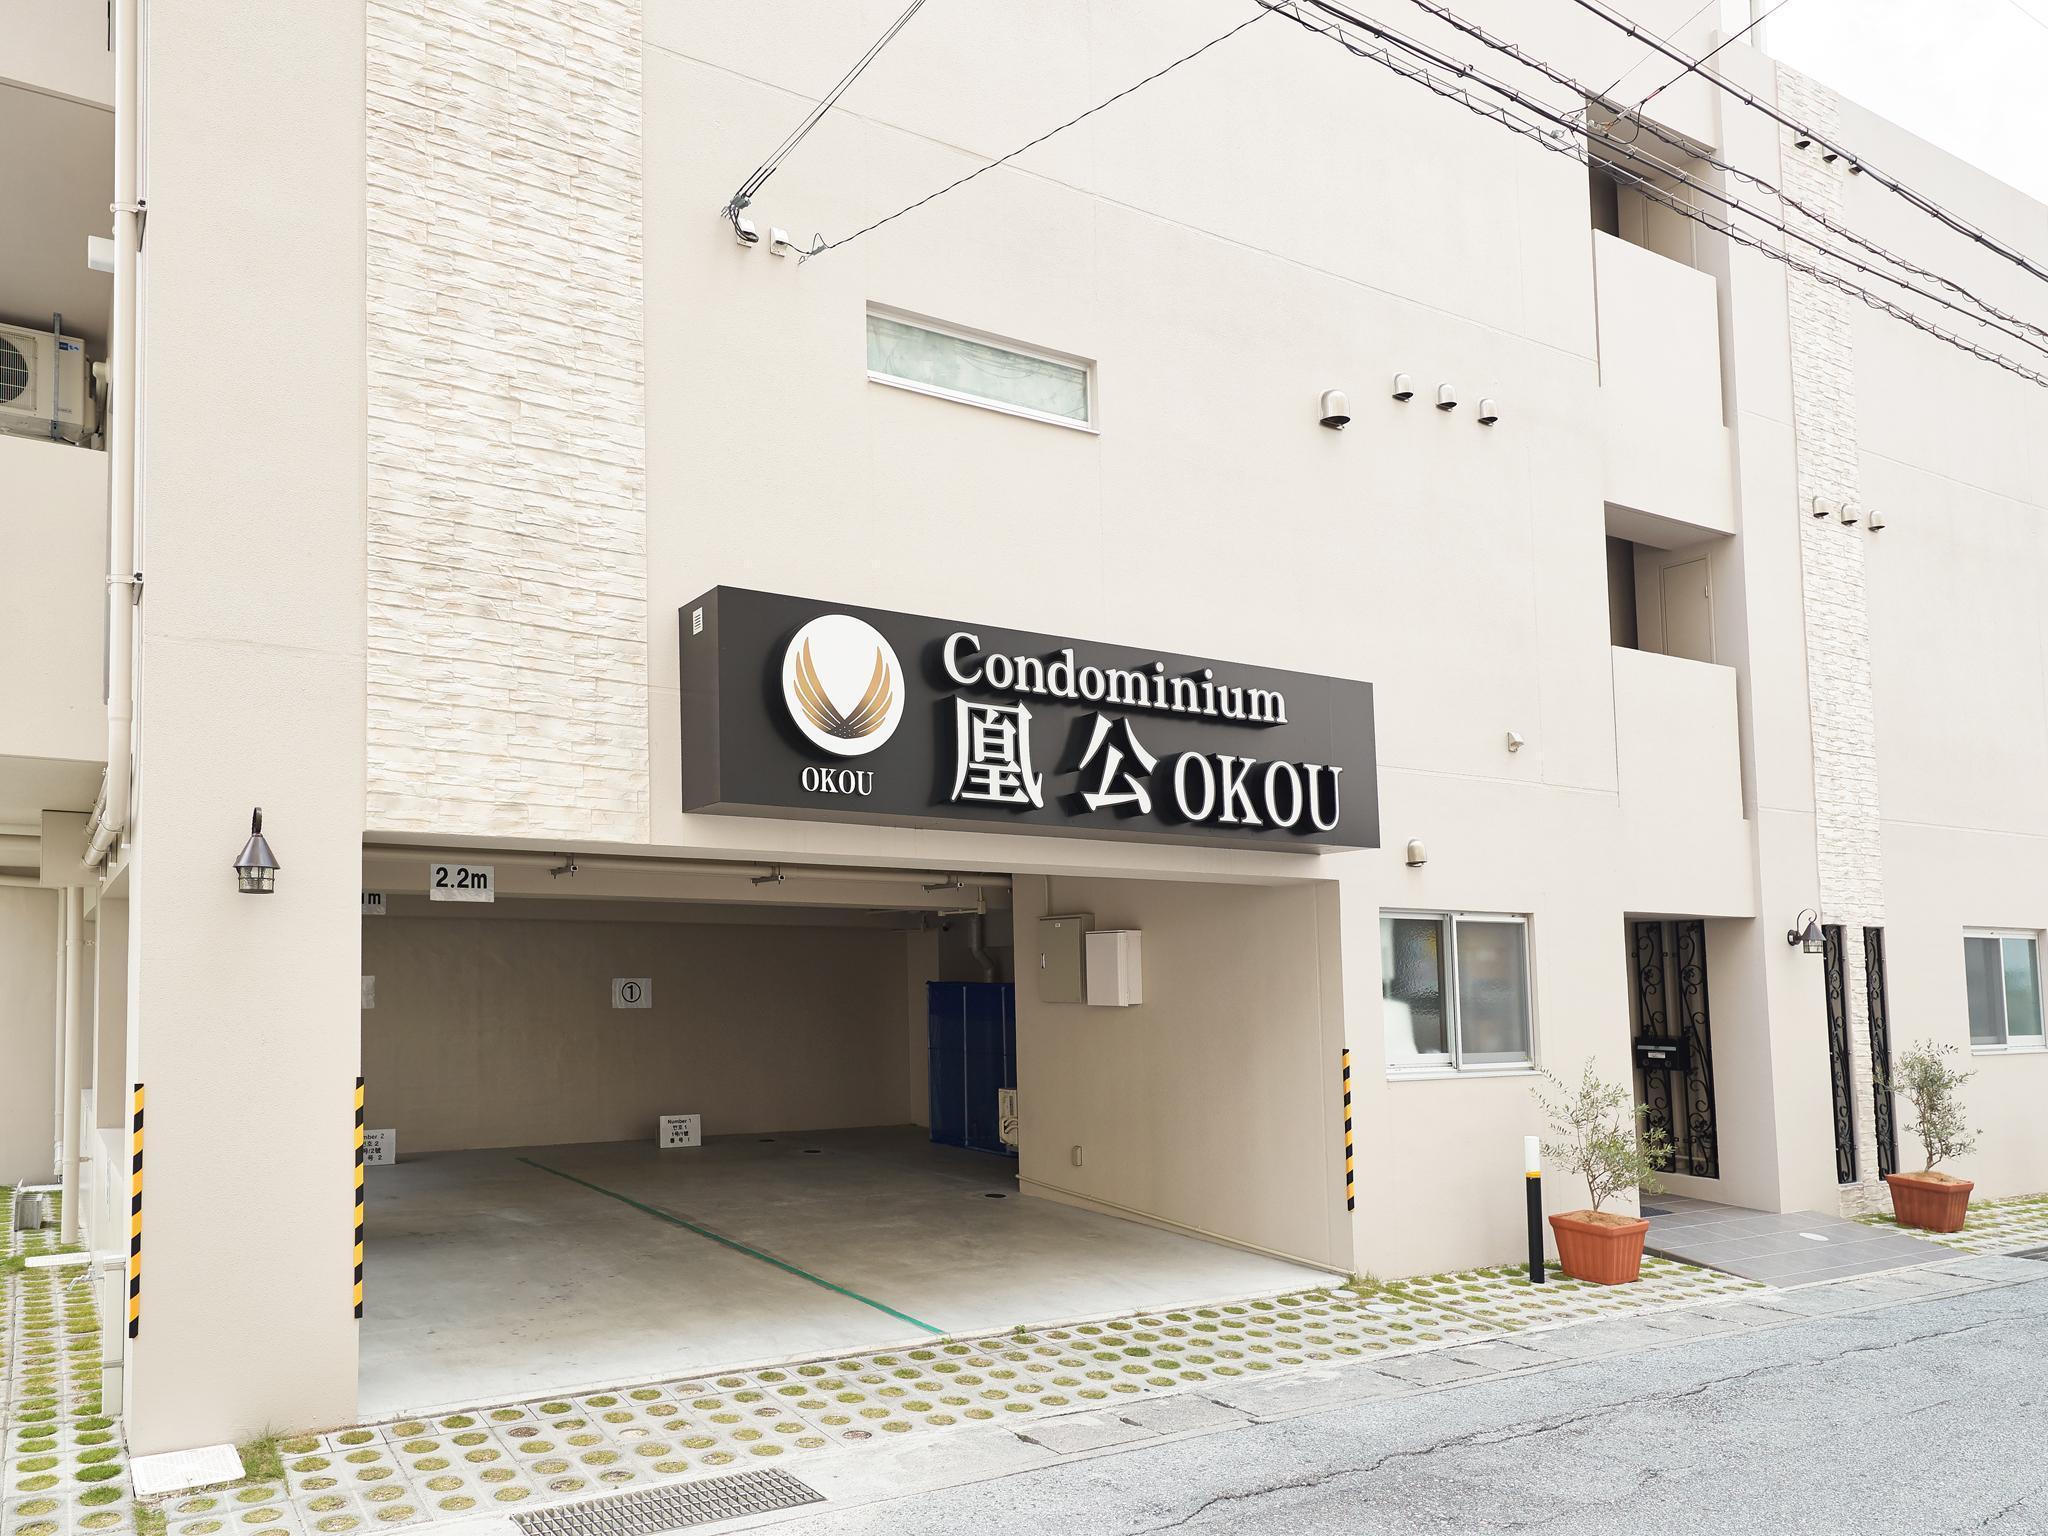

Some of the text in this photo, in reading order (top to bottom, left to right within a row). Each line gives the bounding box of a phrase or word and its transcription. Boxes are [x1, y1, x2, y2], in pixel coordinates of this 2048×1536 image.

[943, 632, 1287, 724] Condominium
[801, 766, 874, 796] OKOU
[1174, 750, 1343, 832] OKOU
[435, 866, 488, 889] 2.2m
